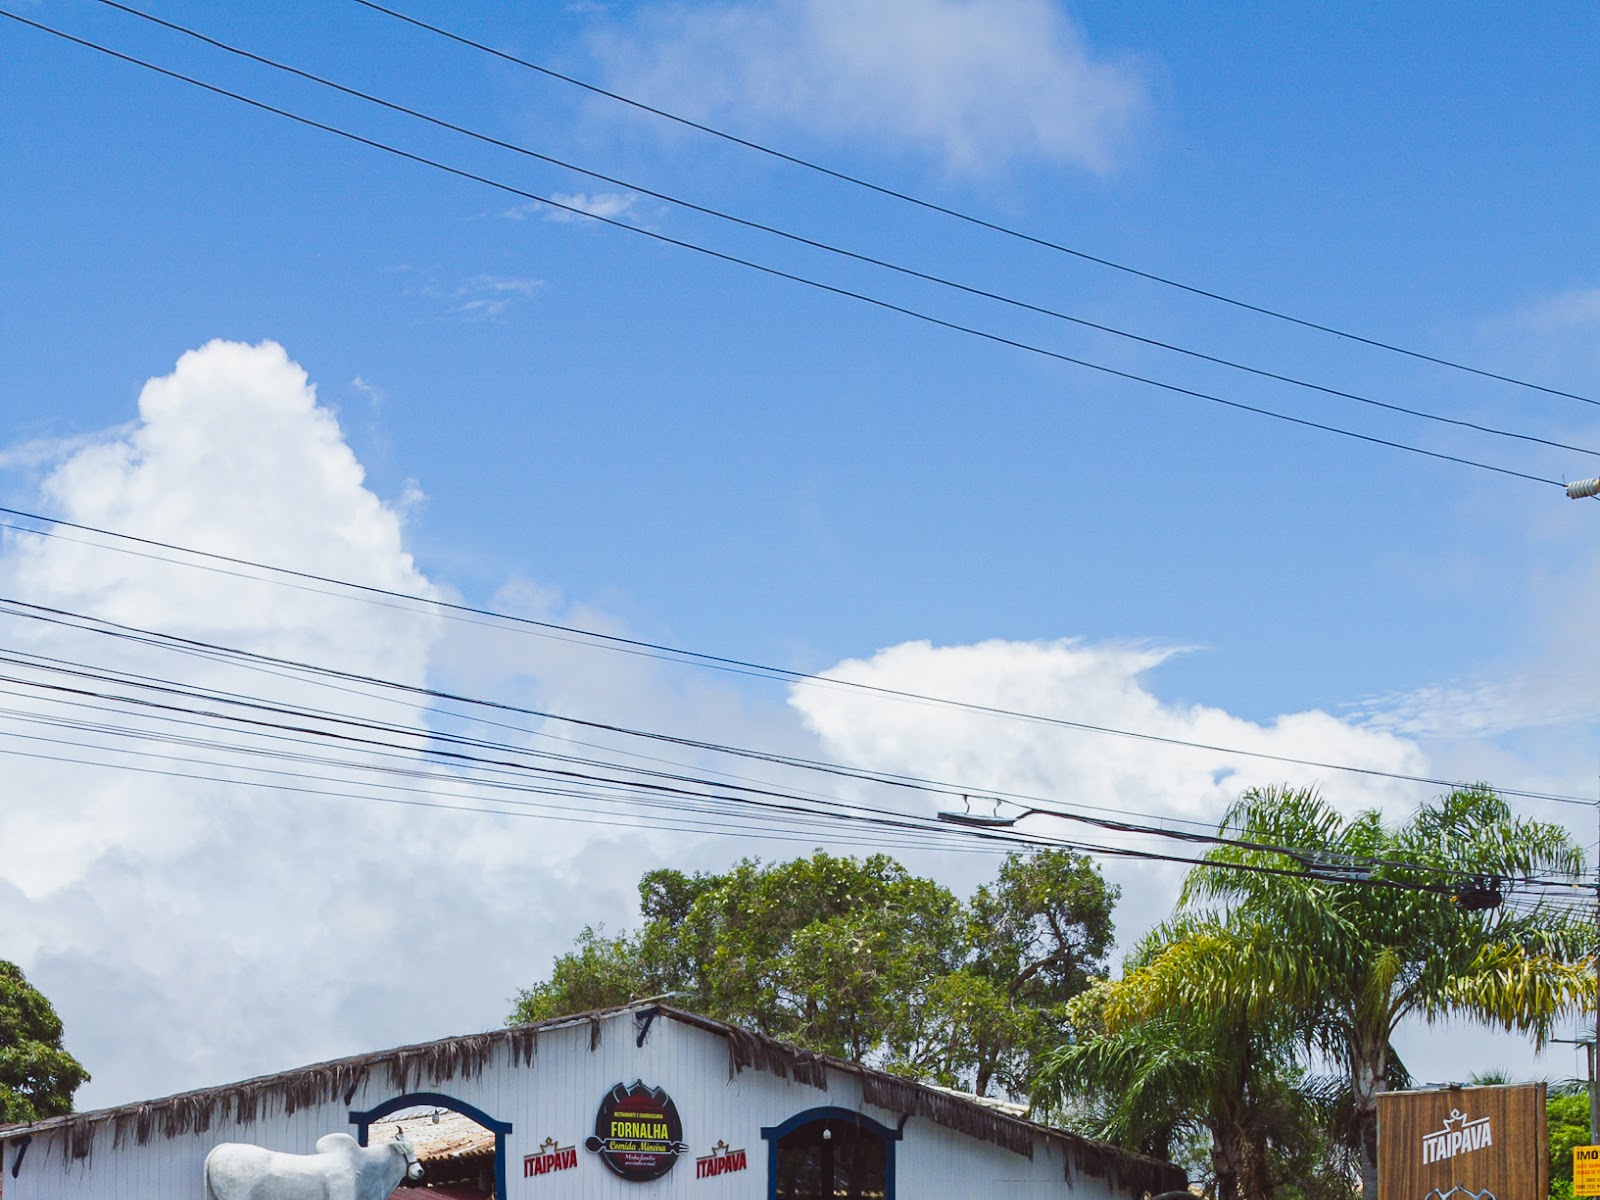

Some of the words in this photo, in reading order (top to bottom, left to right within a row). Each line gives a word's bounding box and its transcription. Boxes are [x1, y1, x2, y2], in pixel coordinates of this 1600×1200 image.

[611, 1121, 669, 1139] FORNALHA
[609, 1140, 636, 1151] Comida
[638, 1142, 666, 1152] Mineira
[1422, 1122, 1493, 1165] ITAIPAVA
[1577, 1148, 1600, 1160] IMÓ
[524, 1149, 578, 1178] ITAIPAVA
[697, 1151, 747, 1180] ITAIPAVA
